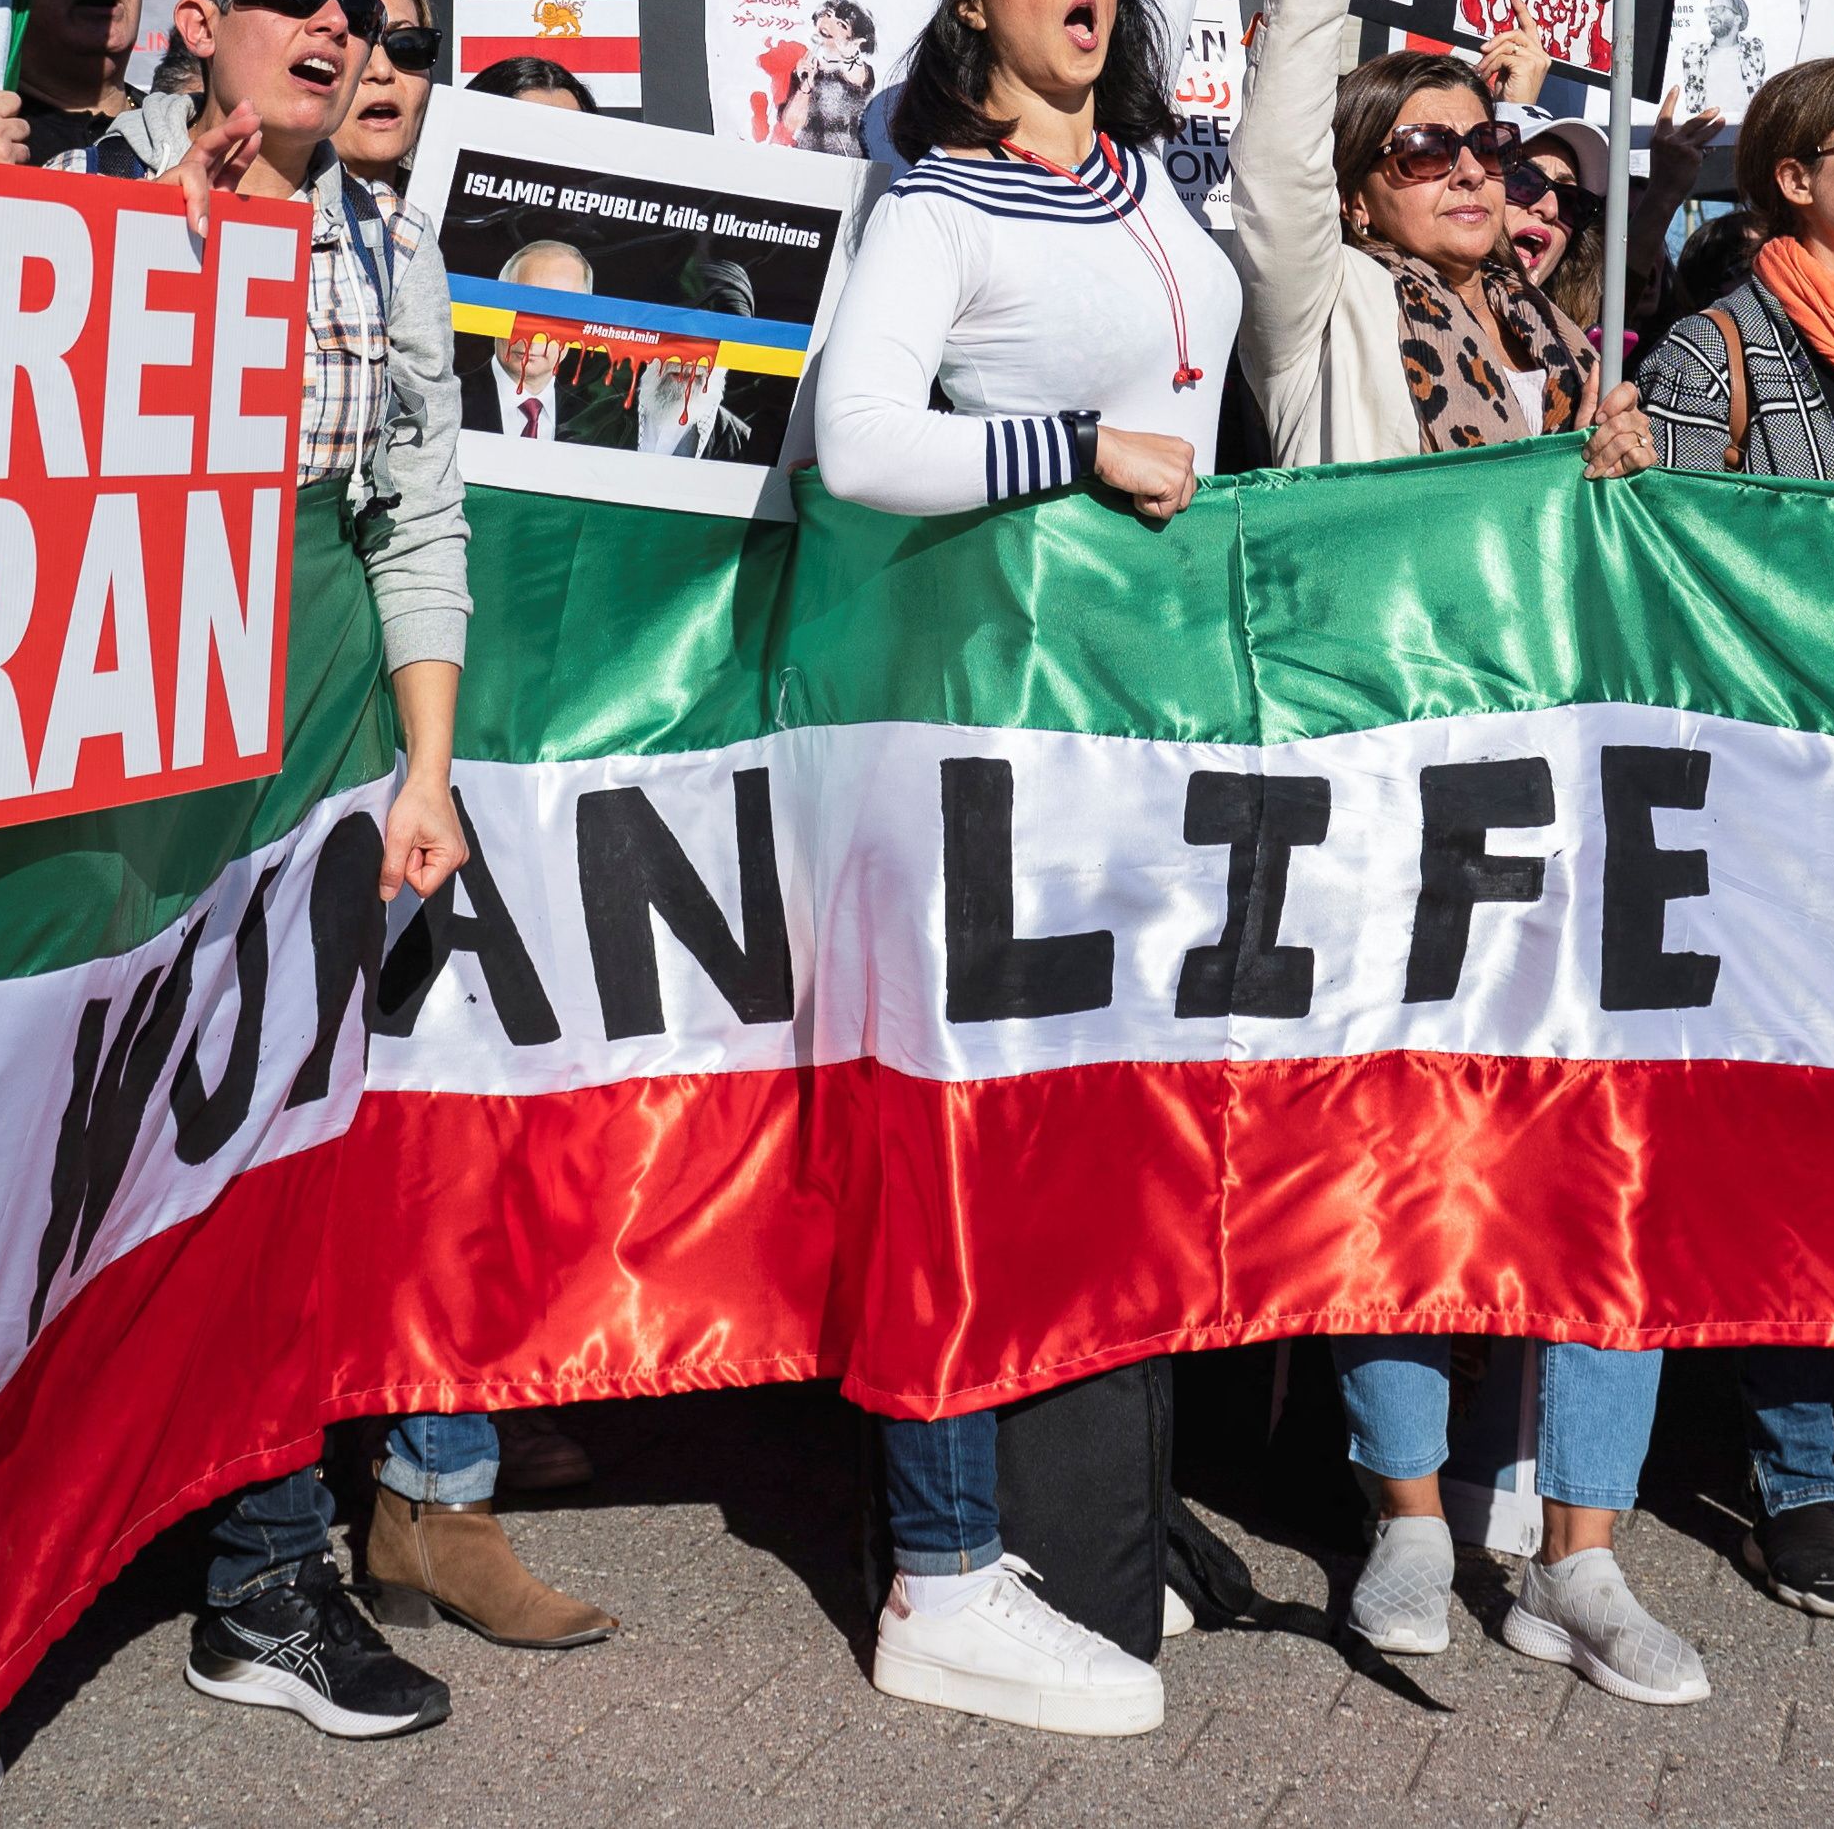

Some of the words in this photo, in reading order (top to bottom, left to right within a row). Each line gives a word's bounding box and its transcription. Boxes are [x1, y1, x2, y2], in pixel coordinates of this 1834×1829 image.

[1167, 150, 1232, 186] OM
[463, 172, 555, 206] ISLAMIC
[558, 188, 661, 225] REPUBLIC
[662, 204, 708, 232] kills
[712, 213, 822, 249] Ukrainians
[1200, 190, 1231, 204] voic
[582, 322, 660, 345] #MahsaAmini
[941, 744, 1721, 1023] LIFE
